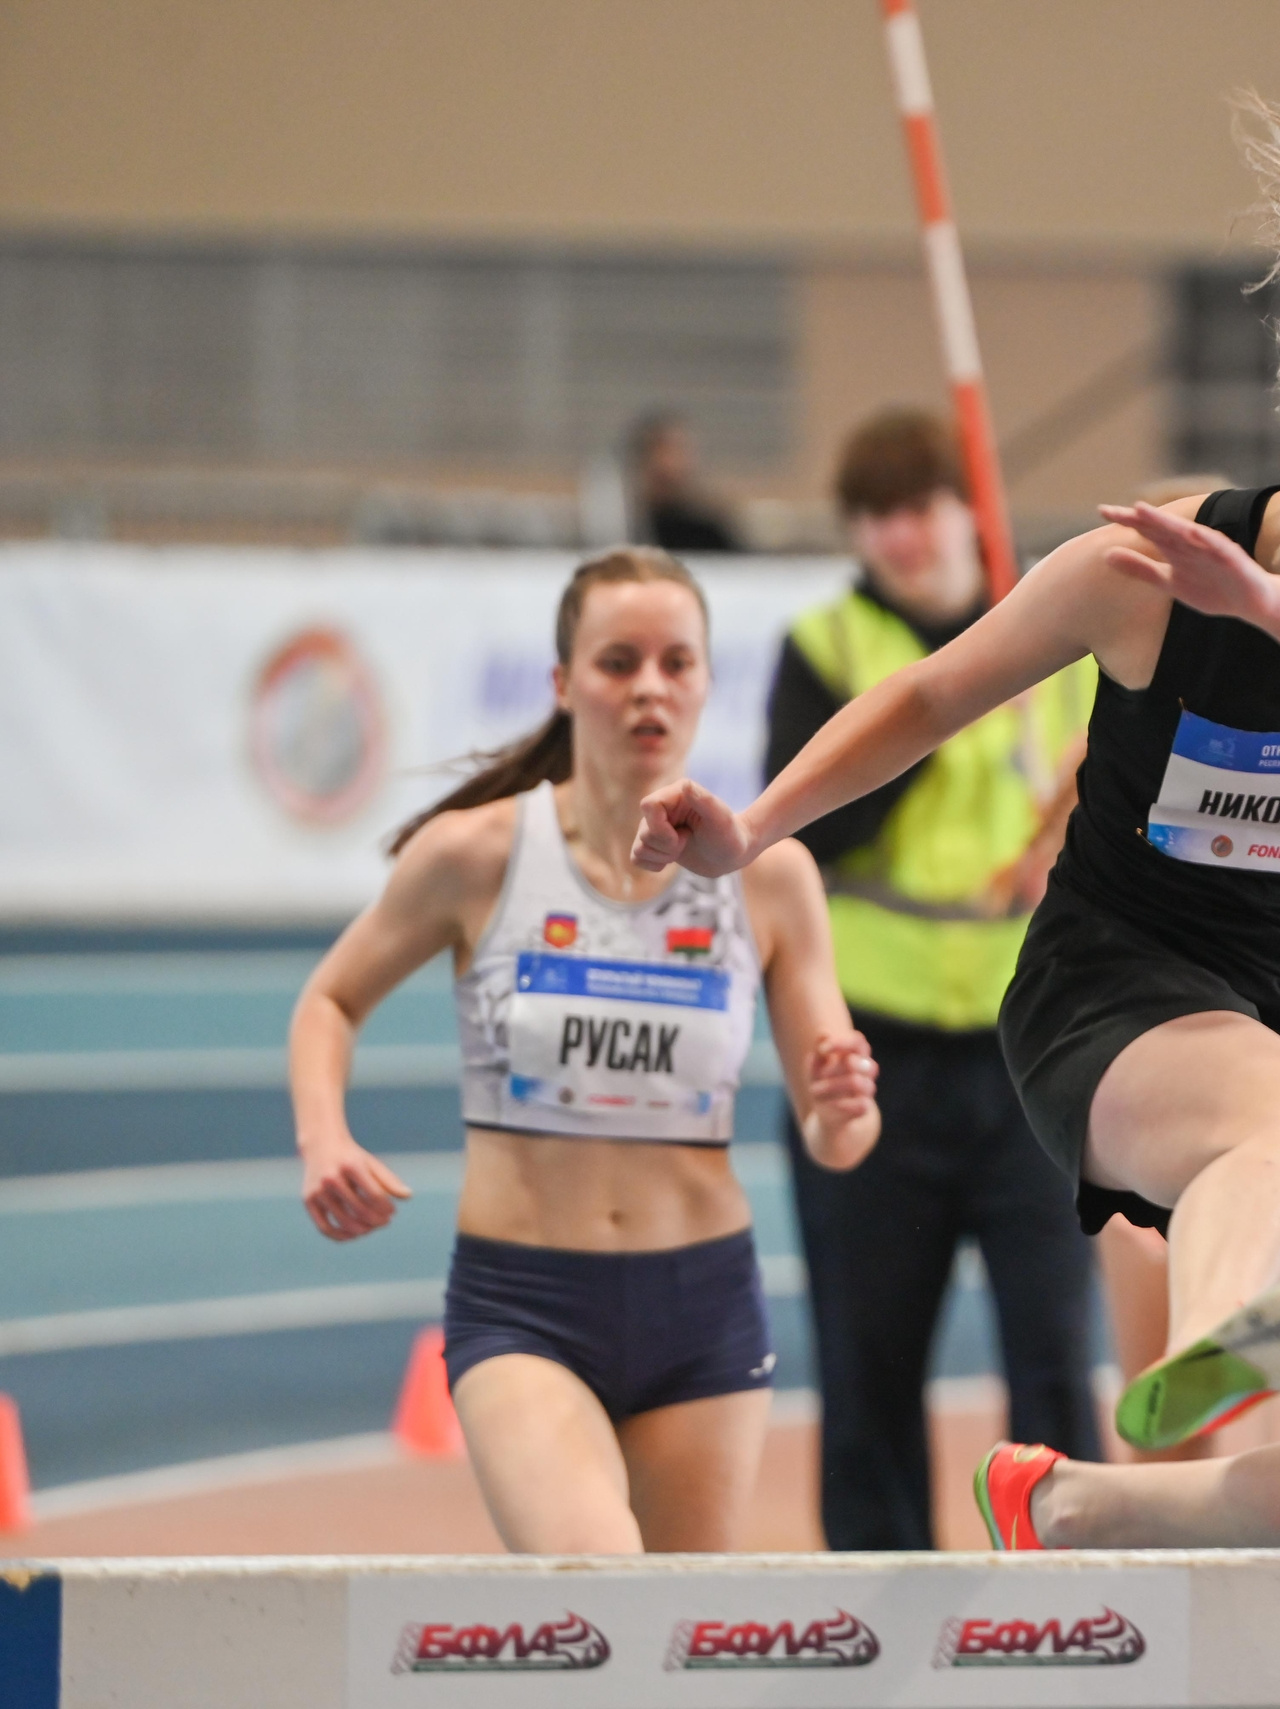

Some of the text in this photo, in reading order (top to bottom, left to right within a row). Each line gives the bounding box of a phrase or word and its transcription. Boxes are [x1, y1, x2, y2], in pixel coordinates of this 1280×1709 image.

[559, 1015, 680, 1074] РУСАК
[415, 1622, 557, 1658] БФЛА
[687, 1619, 827, 1656] БФЛА
[955, 1618, 1093, 1654] БФЛА
